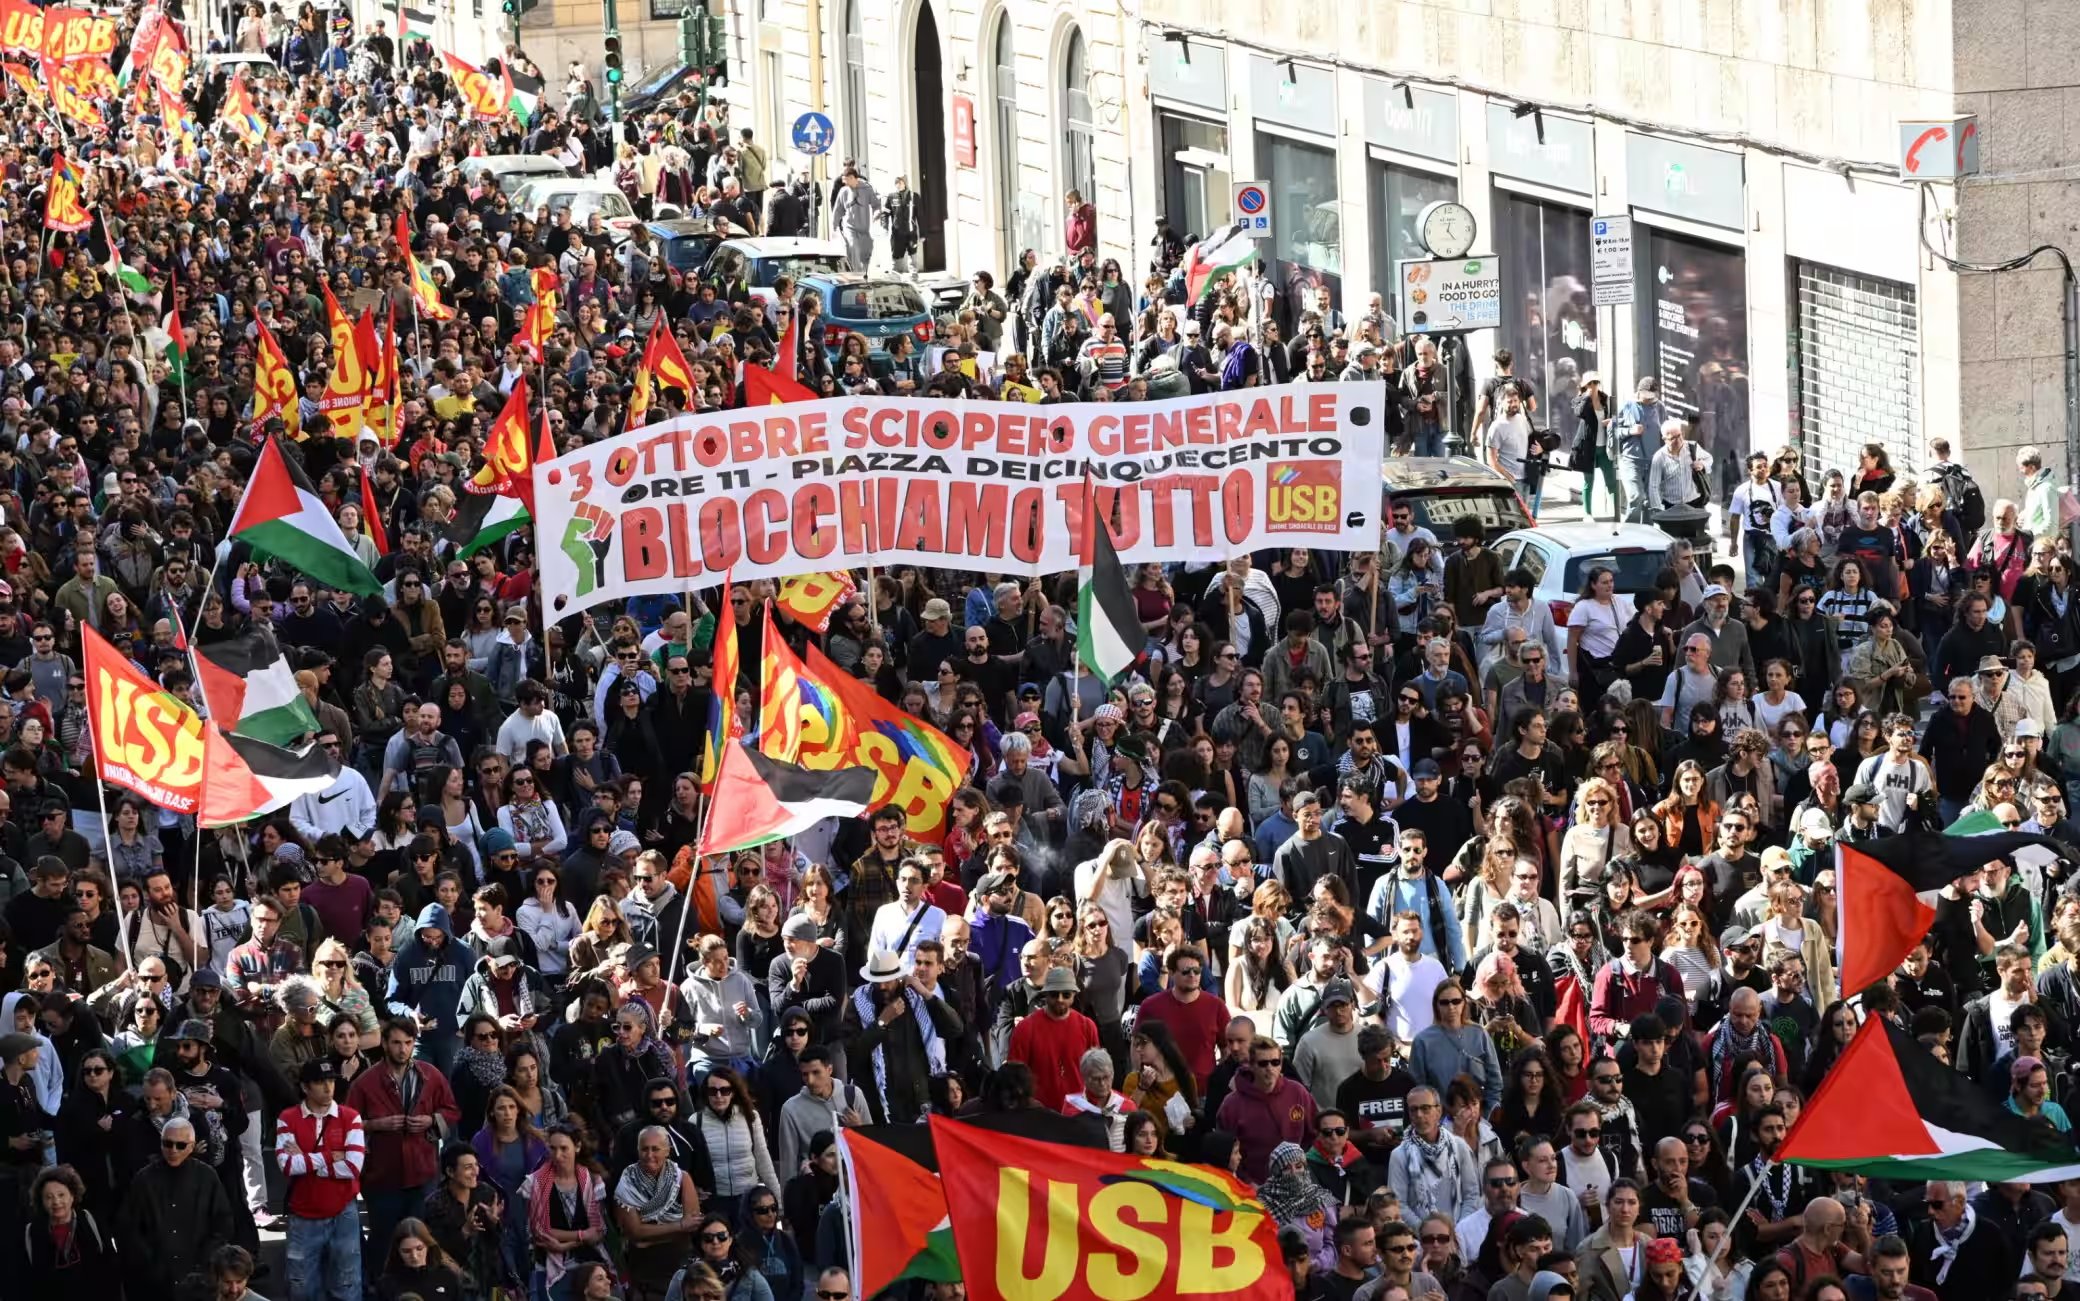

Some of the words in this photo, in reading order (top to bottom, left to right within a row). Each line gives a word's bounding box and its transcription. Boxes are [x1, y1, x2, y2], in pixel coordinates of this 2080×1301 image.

[4, 10, 44, 51] US
[1597, 223, 1605, 234] P
[1440, 291, 1467, 302] FOOD
[1468, 290, 1481, 300] TO
[1482, 289, 1499, 299] GO!
[1442, 283, 1453, 291] IN
[1454, 282, 1463, 290] A
[1463, 278, 1499, 290] HURRY?
[1450, 302, 1468, 312] THE
[1469, 300, 1499, 311] DRINK
[1467, 312, 1476, 320] IS
[569, 459, 593, 502] 3
[605, 412, 829, 486] OTTOBRE
[843, 406, 1074, 456] SCIOPERO
[1087, 393, 1338, 457] GENERALE
[620, 472, 706, 504] ORE
[716, 468, 751, 489] 11
[791, 452, 952, 480] PIAZZA
[966, 457, 1041, 482] DEI
[1268, 483, 1338, 523] USB
[620, 477, 1044, 582] BLOCCHIAMO
[1056, 467, 1254, 557] TUTTO
[99, 666, 205, 787] USB
[857, 731, 952, 834] SB
[1886, 773, 1909, 789] HH
[1359, 1099, 1404, 1116] FREE
[995, 1166, 1267, 1301] USB
